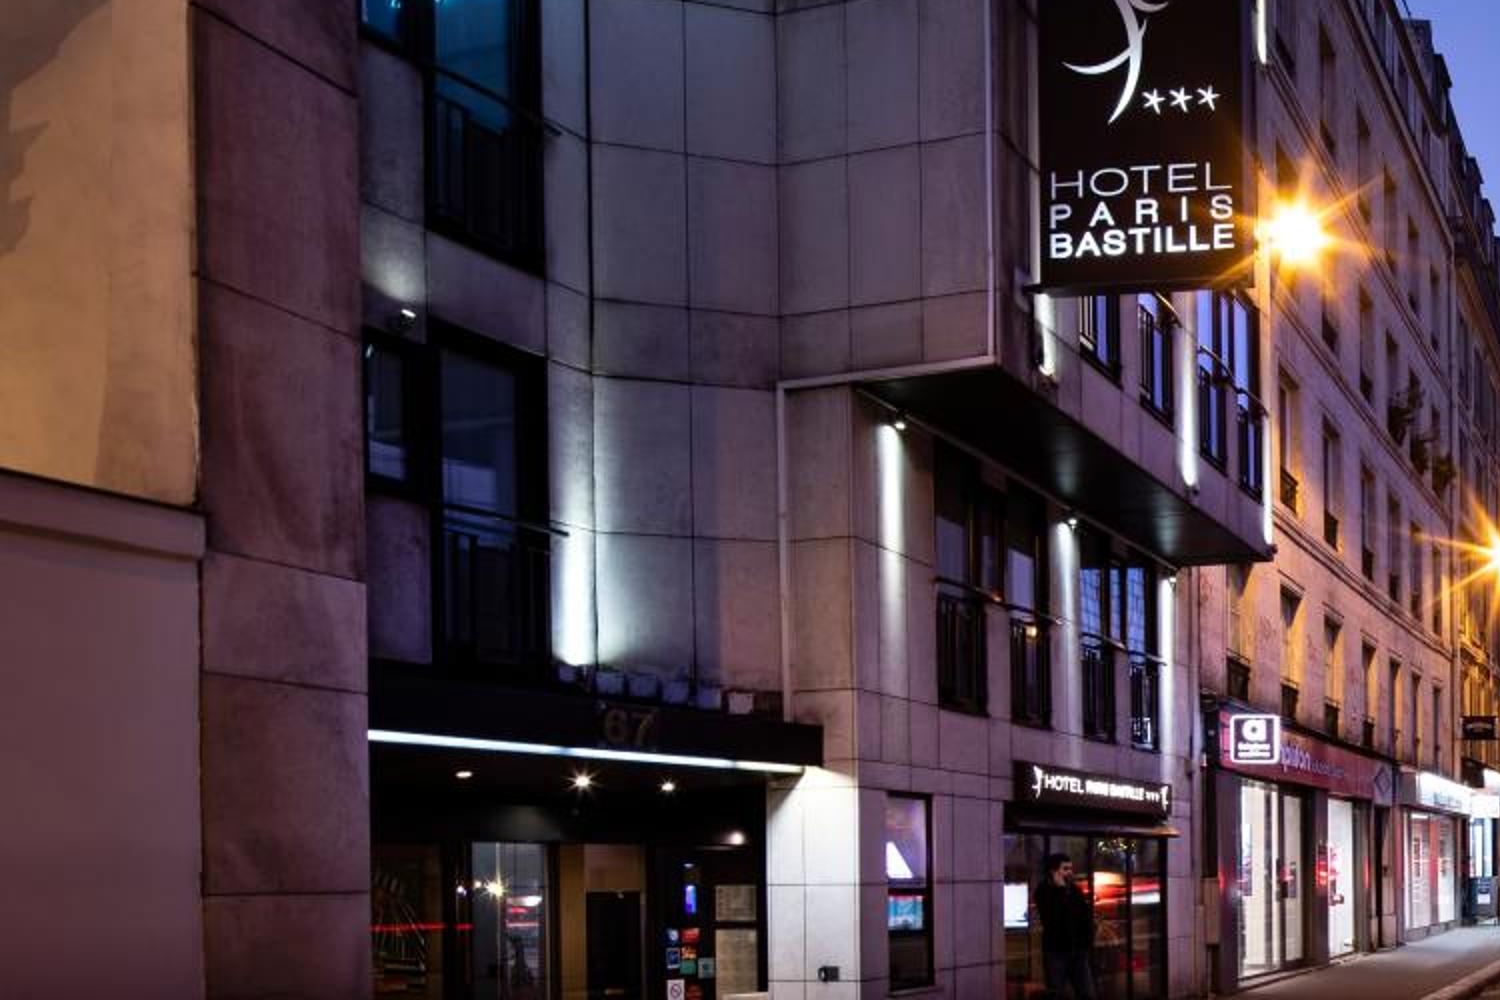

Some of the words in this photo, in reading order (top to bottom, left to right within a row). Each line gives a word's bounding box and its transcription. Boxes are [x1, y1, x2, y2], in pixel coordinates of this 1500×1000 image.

[1050, 162, 1233, 200] HOTEL
[1050, 193, 1234, 230] PARIS
[1049, 223, 1235, 260] BASTILLE
[1044, 773, 1084, 794] HOTEL
